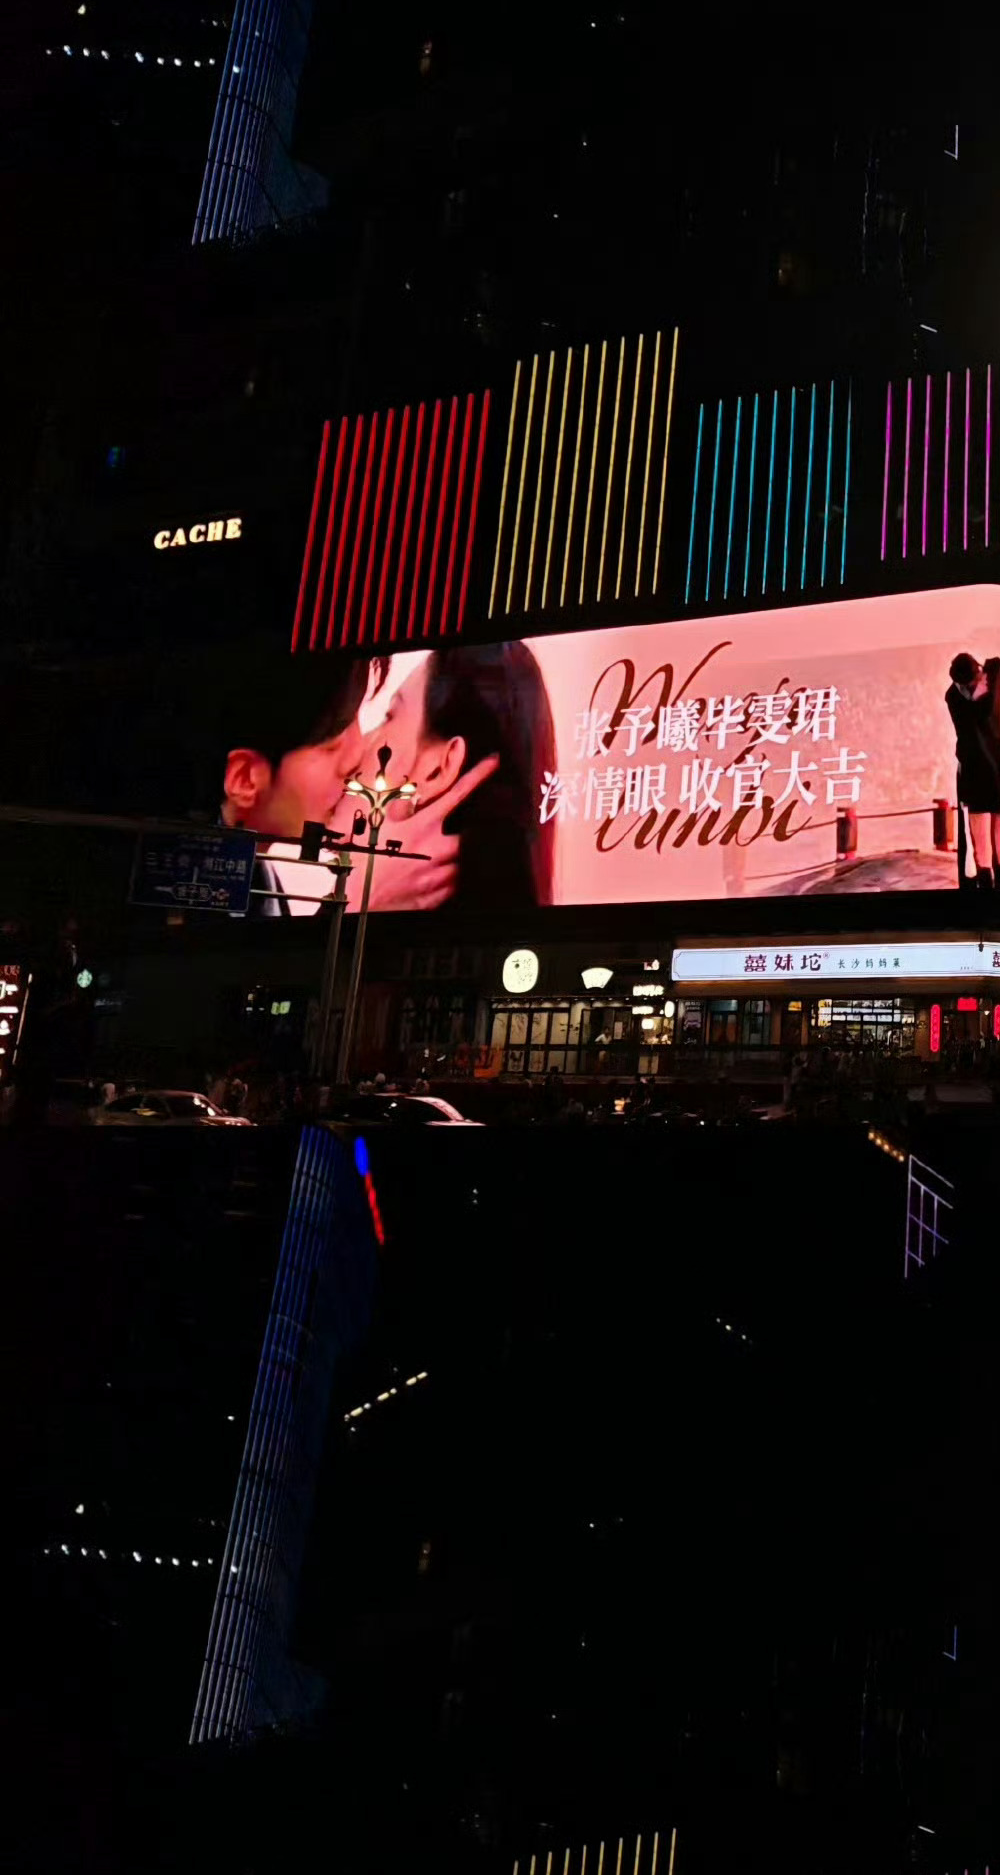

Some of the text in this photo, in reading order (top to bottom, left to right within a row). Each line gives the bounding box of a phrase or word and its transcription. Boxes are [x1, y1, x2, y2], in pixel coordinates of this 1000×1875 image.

[153, 517, 242, 550] CACHE
[574, 685, 843, 760] 张予曦毕雯珺
